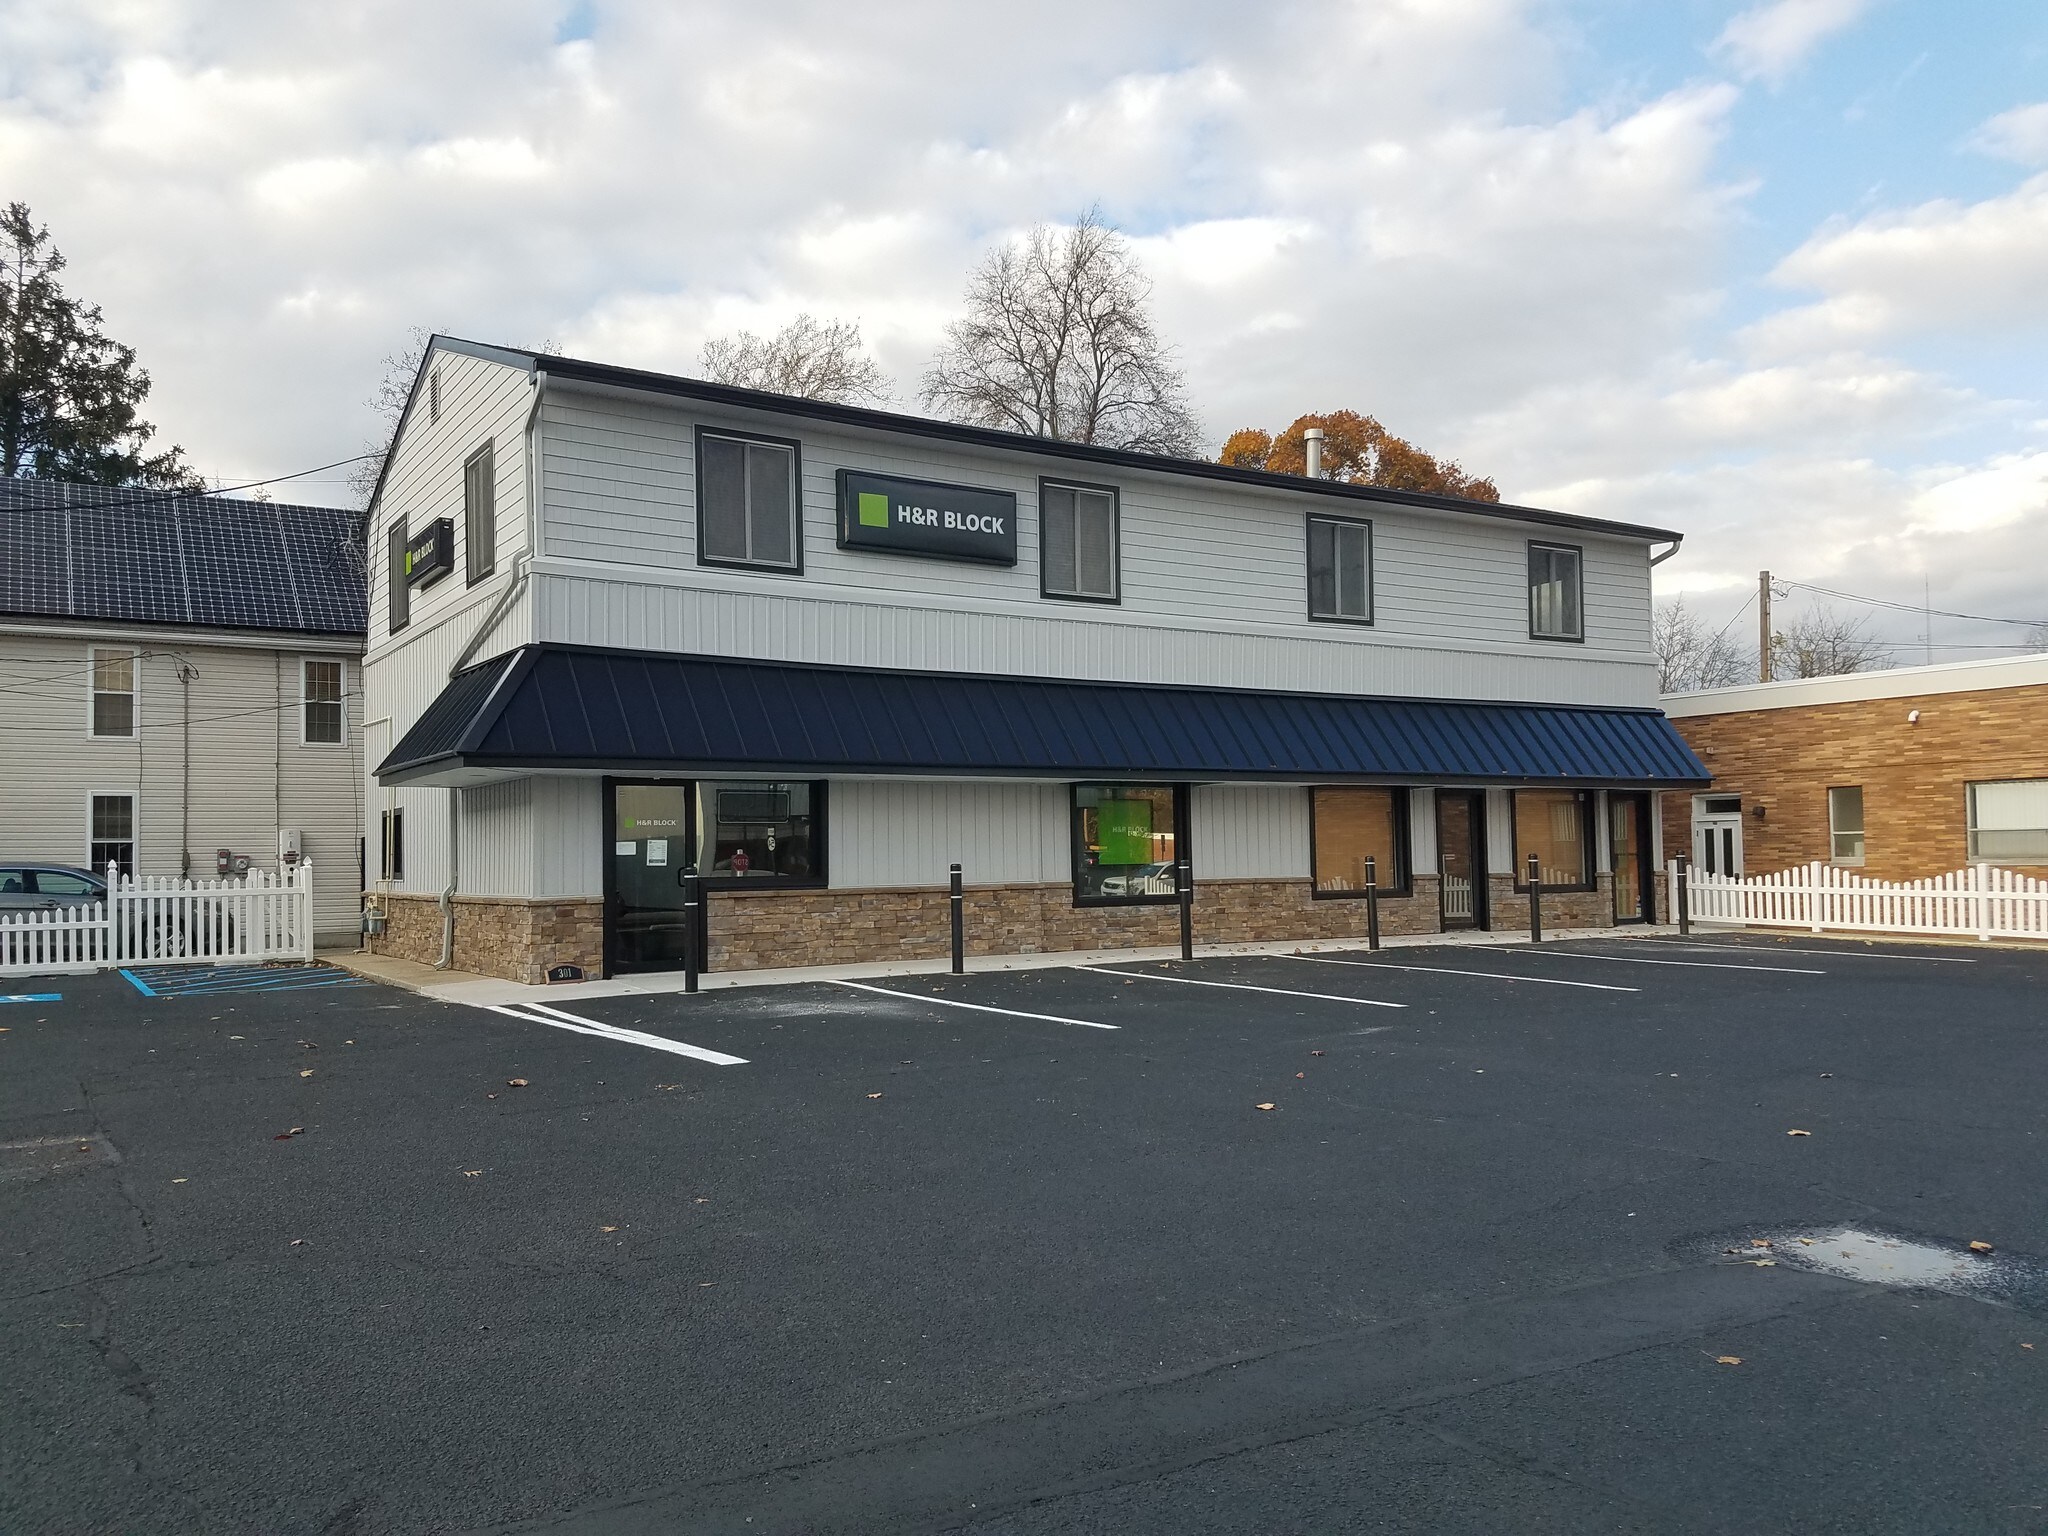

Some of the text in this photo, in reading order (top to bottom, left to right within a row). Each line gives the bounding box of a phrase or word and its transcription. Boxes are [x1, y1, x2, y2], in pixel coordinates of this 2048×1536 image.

[897, 504, 1005, 535] H&R BLOCK
[412, 538, 435, 566] H&R BLOCK
[557, 967, 572, 978] 301
